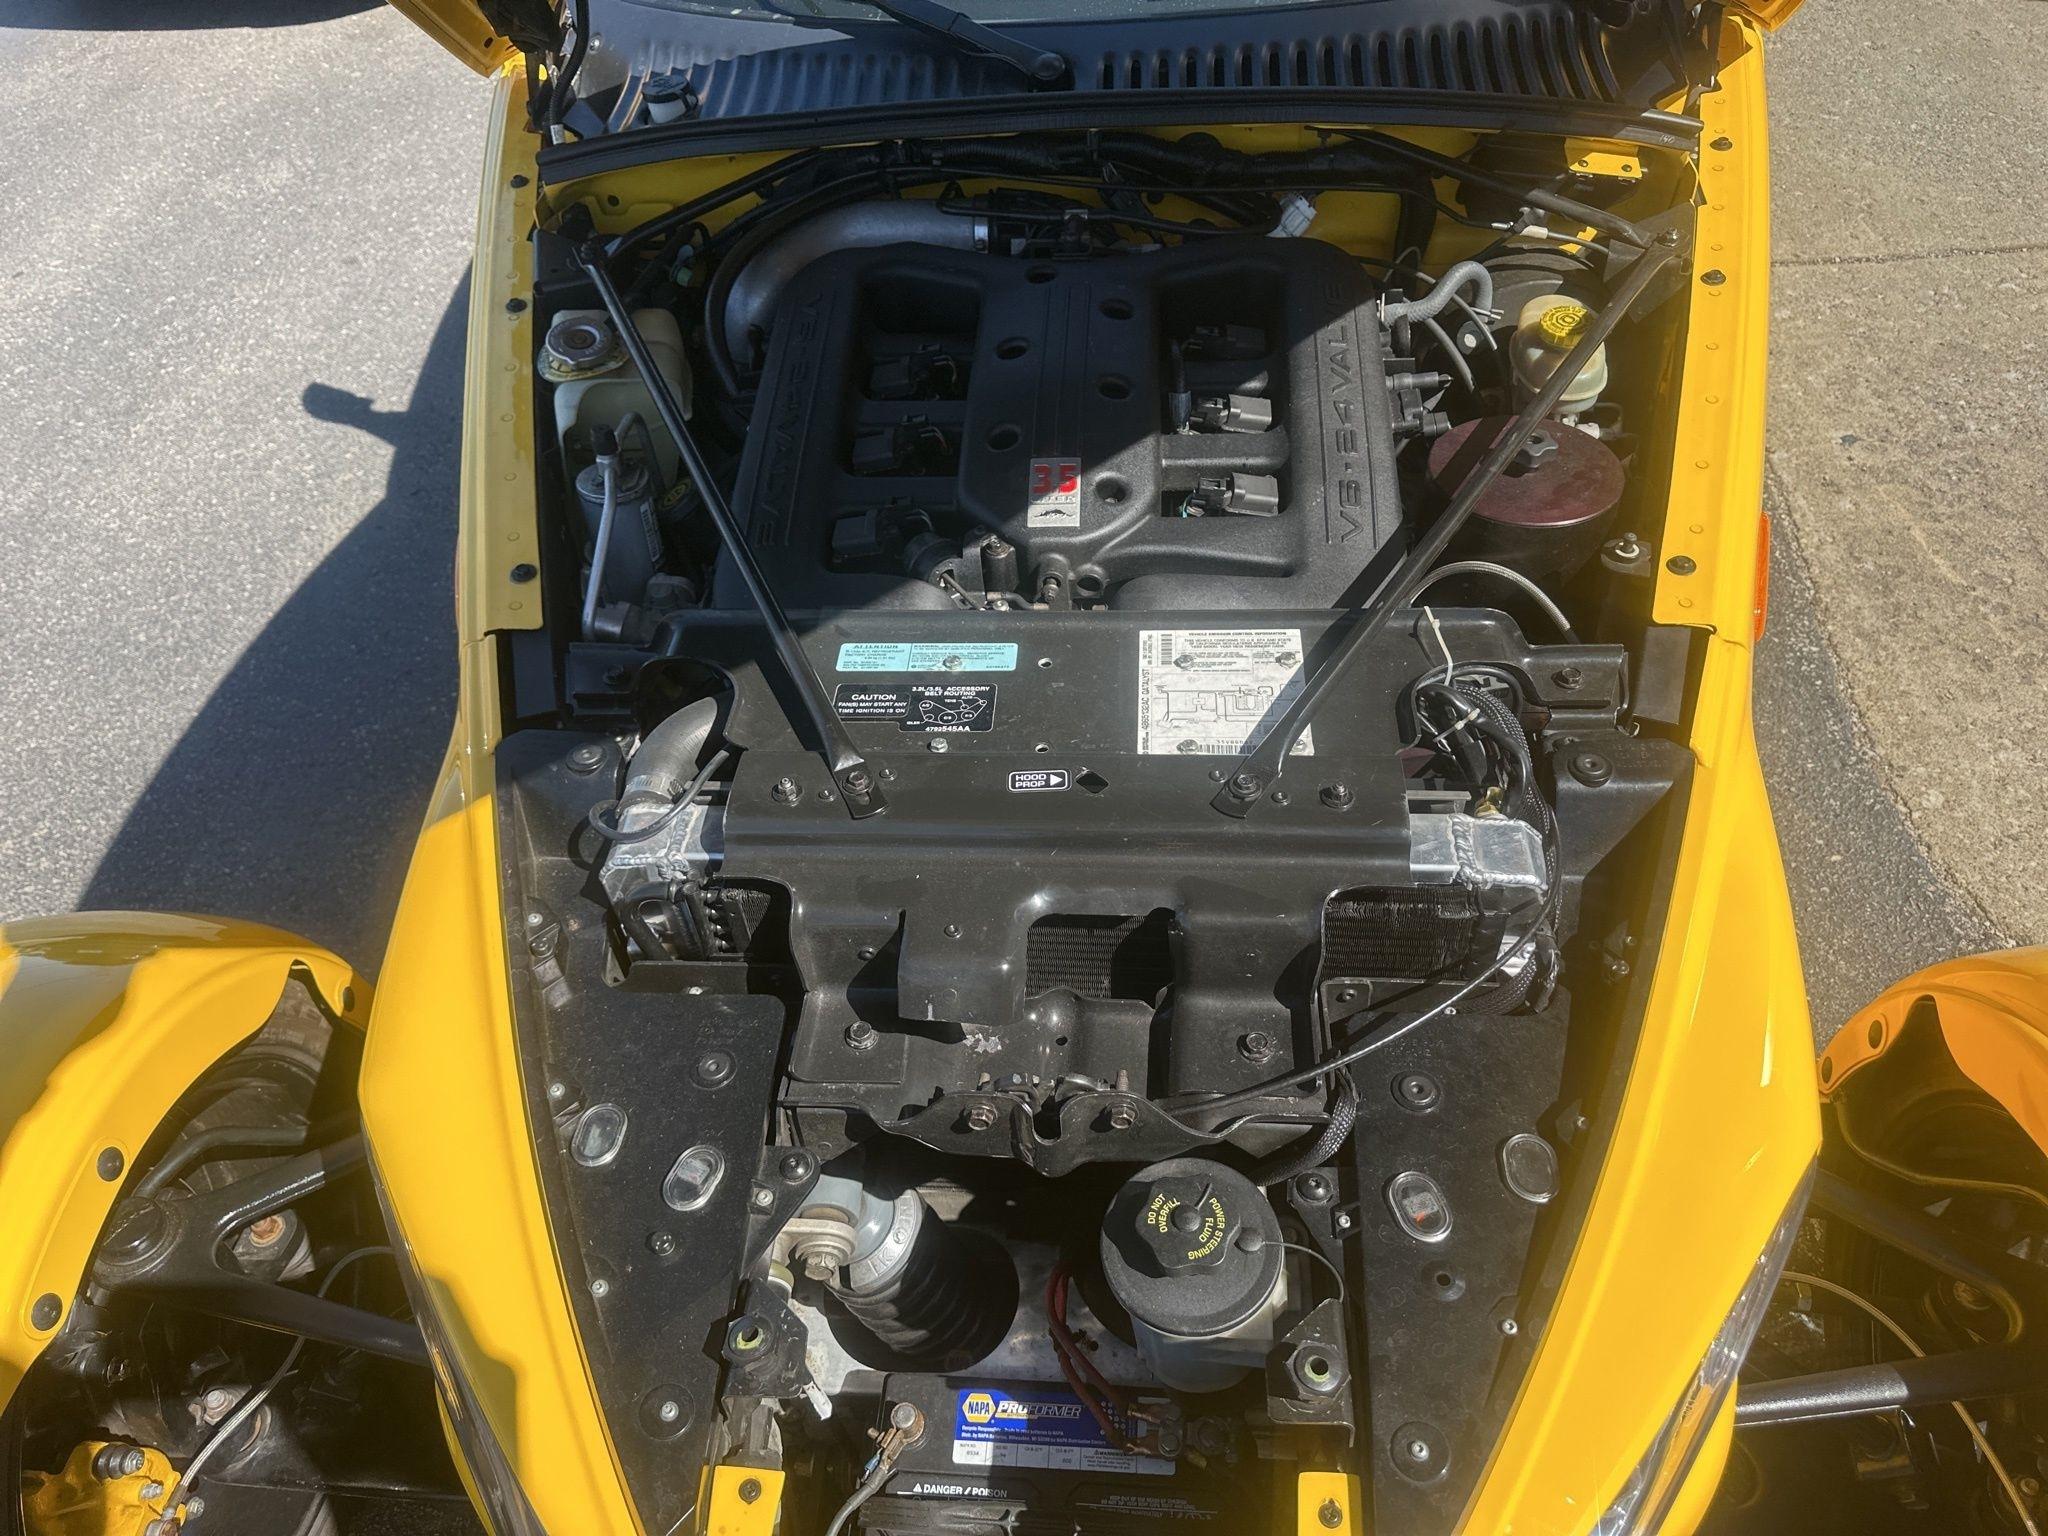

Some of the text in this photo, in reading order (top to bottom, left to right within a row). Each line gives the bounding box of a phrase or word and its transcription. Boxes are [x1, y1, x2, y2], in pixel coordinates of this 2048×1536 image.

[1147, 1193, 1166, 1224] DO NOT
[1158, 1197, 1181, 1233] OVERFILL
[1187, 1197, 1226, 1260] POWER STEERING
[1198, 1217, 1214, 1243] FLUID
[968, 1401, 990, 1415] NAPA
[998, 1402, 1082, 1417] PROFORMER
[923, 1484, 963, 1495] DANGER
[972, 1487, 1008, 1498] POISON
